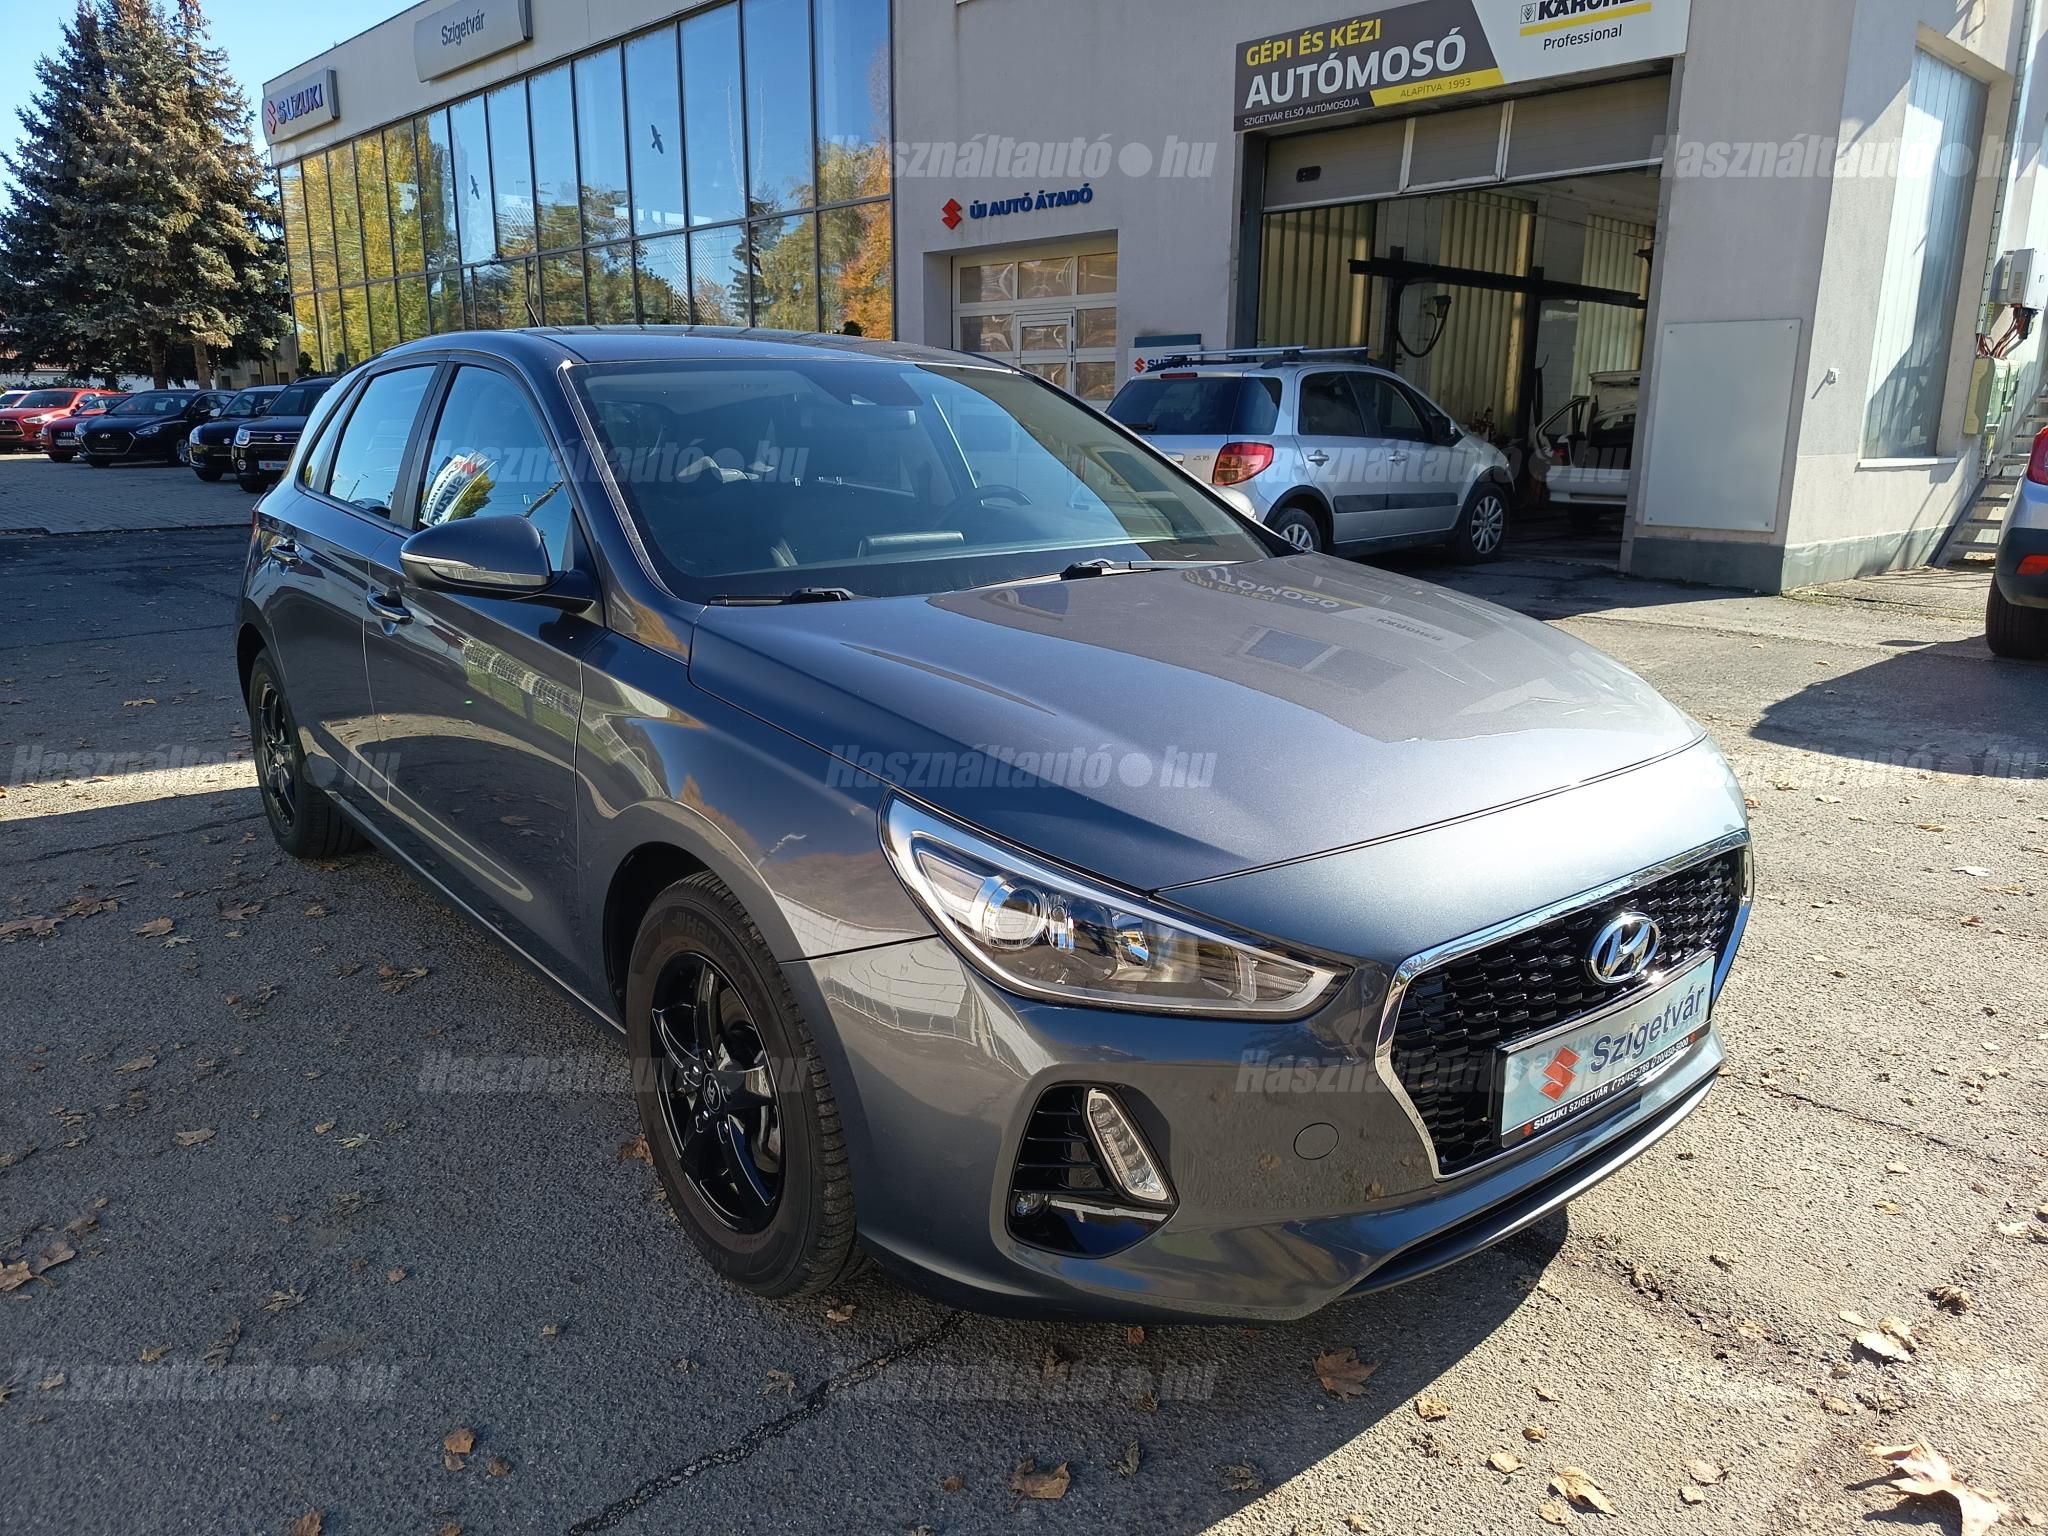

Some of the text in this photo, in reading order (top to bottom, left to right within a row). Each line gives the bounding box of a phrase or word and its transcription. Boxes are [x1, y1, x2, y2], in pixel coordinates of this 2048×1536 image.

[441, 10, 485, 46] Szigetvár
[1246, 18, 1382, 66] GÉPI ÉS KÉZI
[1543, 24, 1623, 51] Professional
[1245, 27, 1467, 109] AUTÓMOSÓ
[1448, 77, 1472, 90] 1993
[277, 83, 324, 125] SUZUKI
[1244, 110, 1283, 126] SZIGETVÁR
[989, 192, 1033, 217] AUTÓ
[1034, 183, 1094, 210] ÁTADÓ
[1590, 984, 1705, 1073] Szigetvár
[1534, 1107, 1567, 1130] SUZUKI
[1568, 1086, 1608, 1113] SZIGETVÁR
